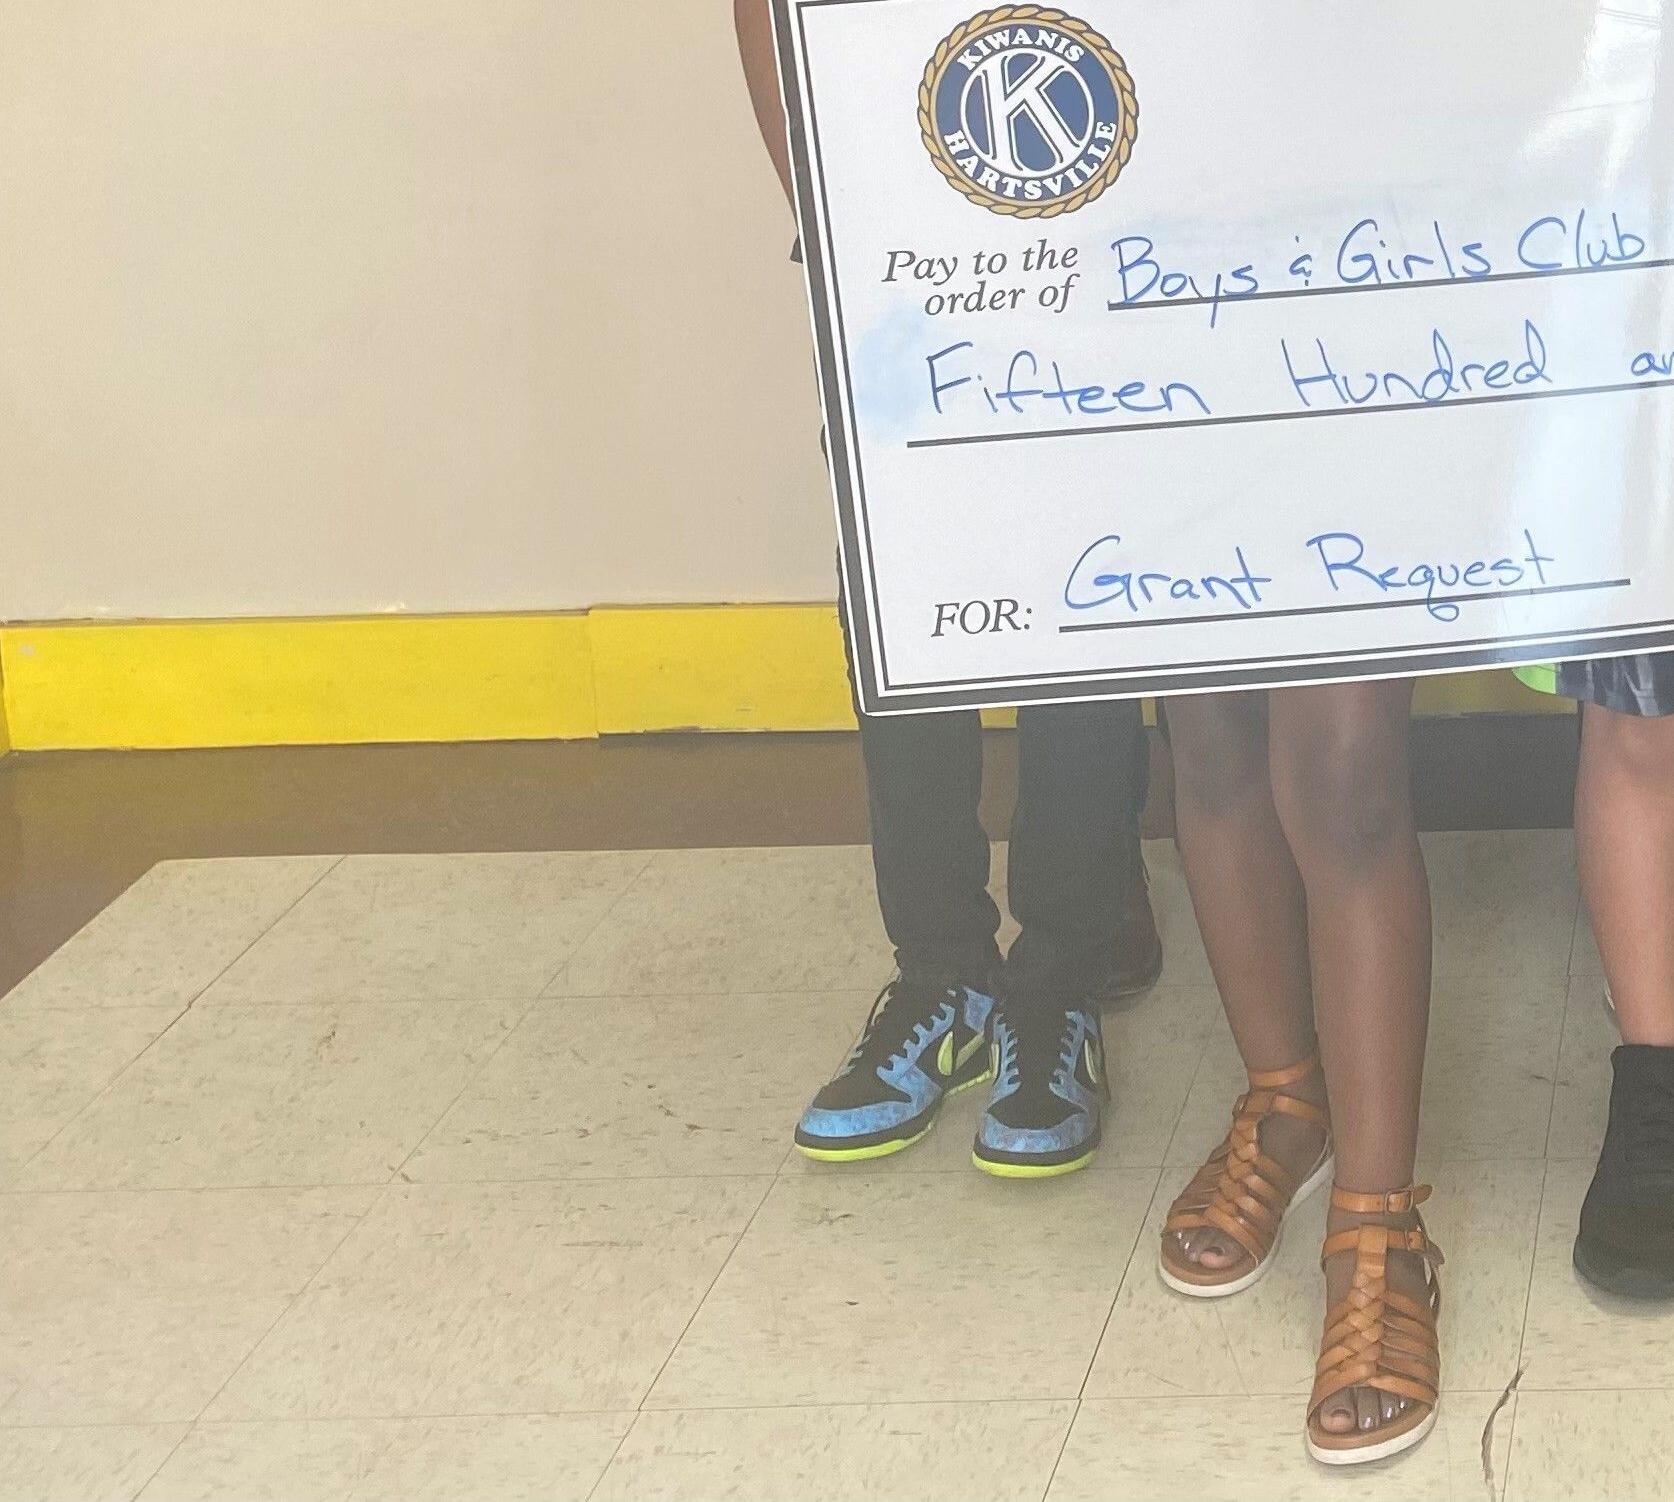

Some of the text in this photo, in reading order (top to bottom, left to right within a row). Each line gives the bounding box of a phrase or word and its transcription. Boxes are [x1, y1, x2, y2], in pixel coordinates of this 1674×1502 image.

[956, 28, 1085, 71] KIWANIS
[944, 121, 1117, 200] HARTSVILLE
[881, 239, 1078, 287] Pay to the
[1111, 236, 1260, 329] Boys
[1337, 219, 1492, 285] Girls
[1517, 208, 1645, 271] Club
[924, 274, 1080, 316] order of
[926, 341, 1212, 415] Fifteen
[1281, 319, 1552, 407] Hundred
[1064, 529, 1555, 622] Grant Request
[931, 598, 1032, 637] FOR:
